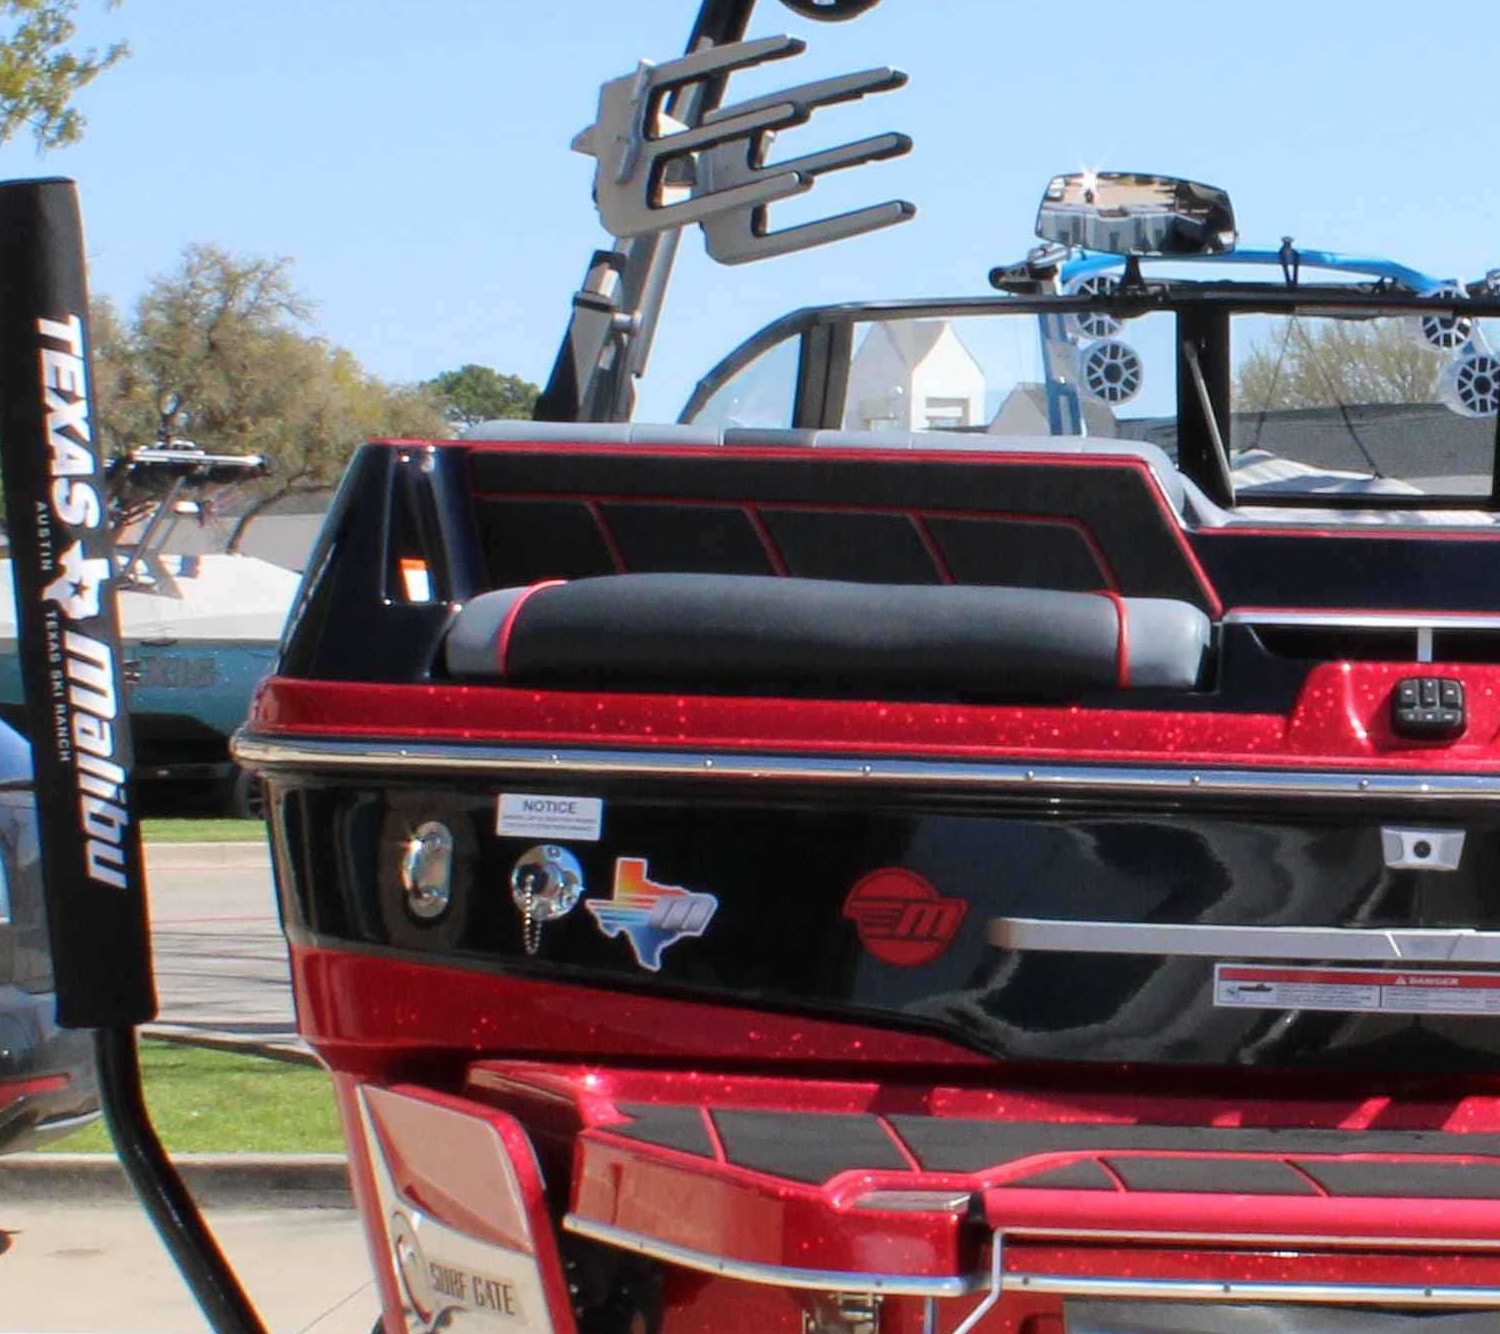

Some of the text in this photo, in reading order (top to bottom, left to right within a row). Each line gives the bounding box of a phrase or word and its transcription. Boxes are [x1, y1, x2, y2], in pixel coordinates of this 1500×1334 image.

[37, 314, 100, 528] TEXAS
[34, 501, 72, 763] AUSTIN TEXAS SKI RANCH
[522, 799, 578, 815] NOTICE
[427, 1261, 517, 1316] SURF GATE
